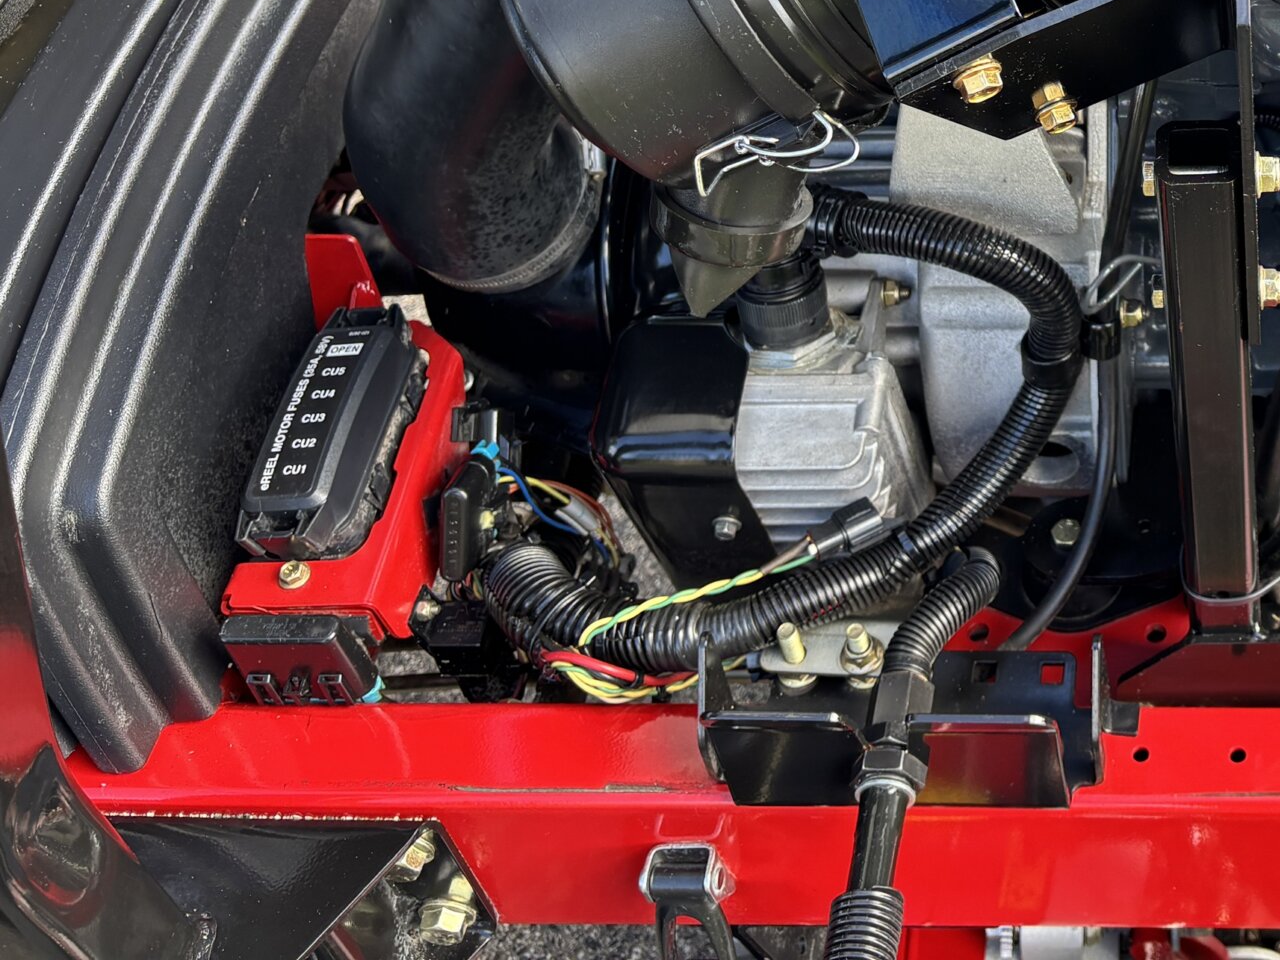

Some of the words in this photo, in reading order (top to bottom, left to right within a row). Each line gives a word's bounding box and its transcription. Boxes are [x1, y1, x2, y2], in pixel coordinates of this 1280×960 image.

[330, 344, 361, 355] OPEN
[321, 366, 347, 377] CU5
[311, 389, 336, 400] CU4
[301, 413, 327, 424] CU3
[260, 453, 280, 491] eREEL
[271, 413, 295, 454] MOTOR
[287, 378, 310, 412] FUSES
[292, 437, 317, 449] CU2
[282, 464, 307, 476] CU1
